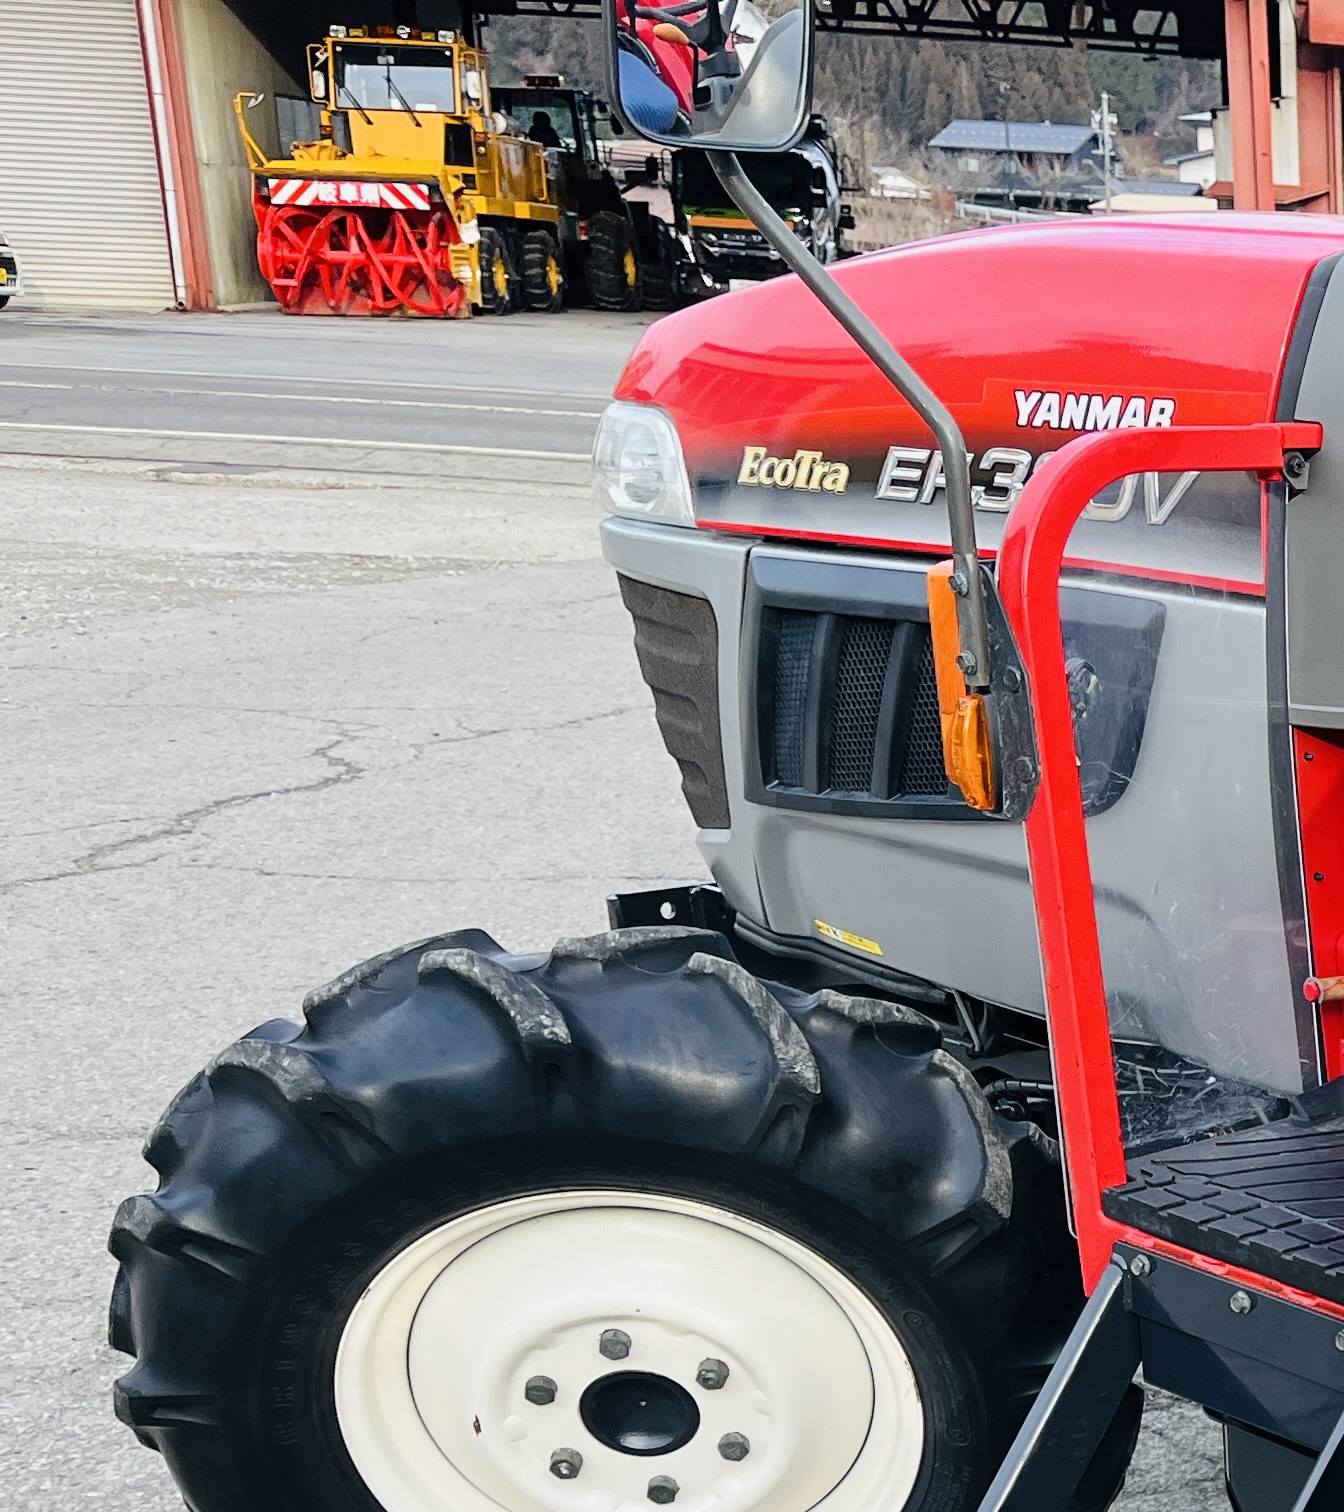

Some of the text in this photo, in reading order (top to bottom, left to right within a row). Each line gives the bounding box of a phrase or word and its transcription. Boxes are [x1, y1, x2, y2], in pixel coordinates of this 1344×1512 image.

[1013, 389, 1176, 431] YANMAR
[736, 446, 850, 494] EcoTra
[874, 445, 1201, 526] EF3V
